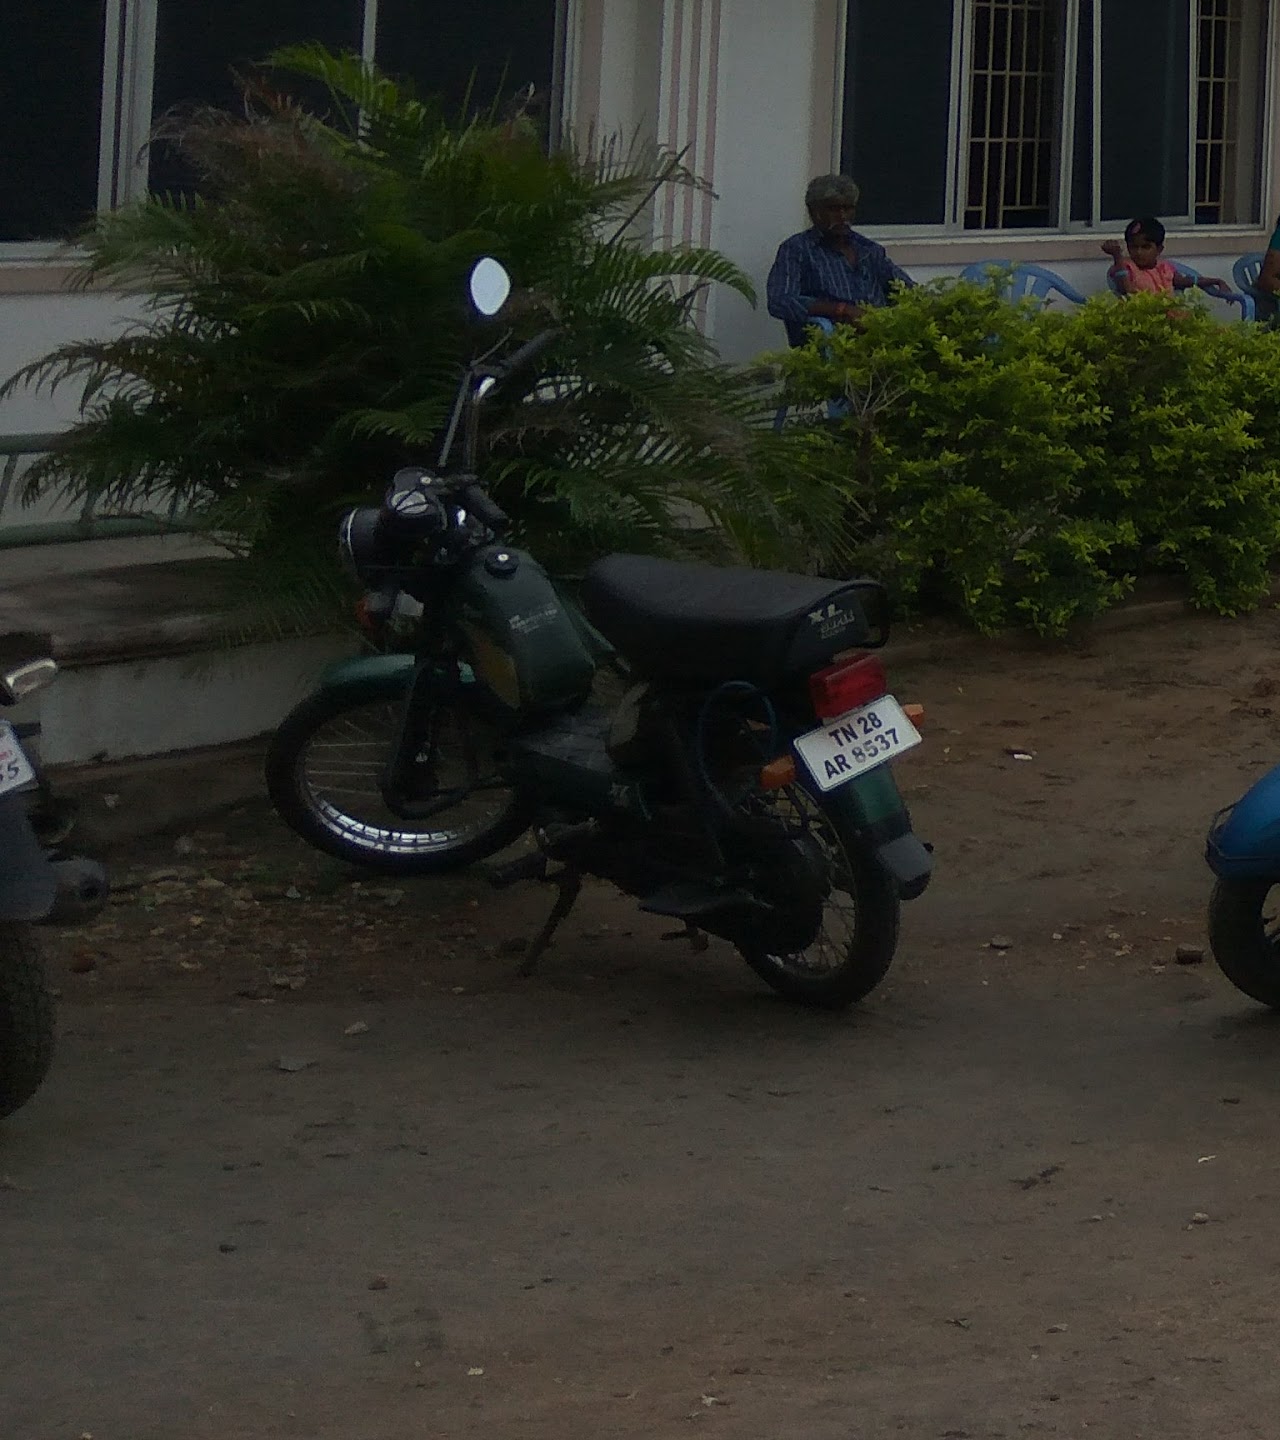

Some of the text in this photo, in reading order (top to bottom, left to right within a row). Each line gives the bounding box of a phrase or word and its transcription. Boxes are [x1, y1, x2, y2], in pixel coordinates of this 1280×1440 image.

[808, 604, 843, 625] XL
[829, 712, 883, 747] TN 28
[823, 728, 900, 779] AR 8537
